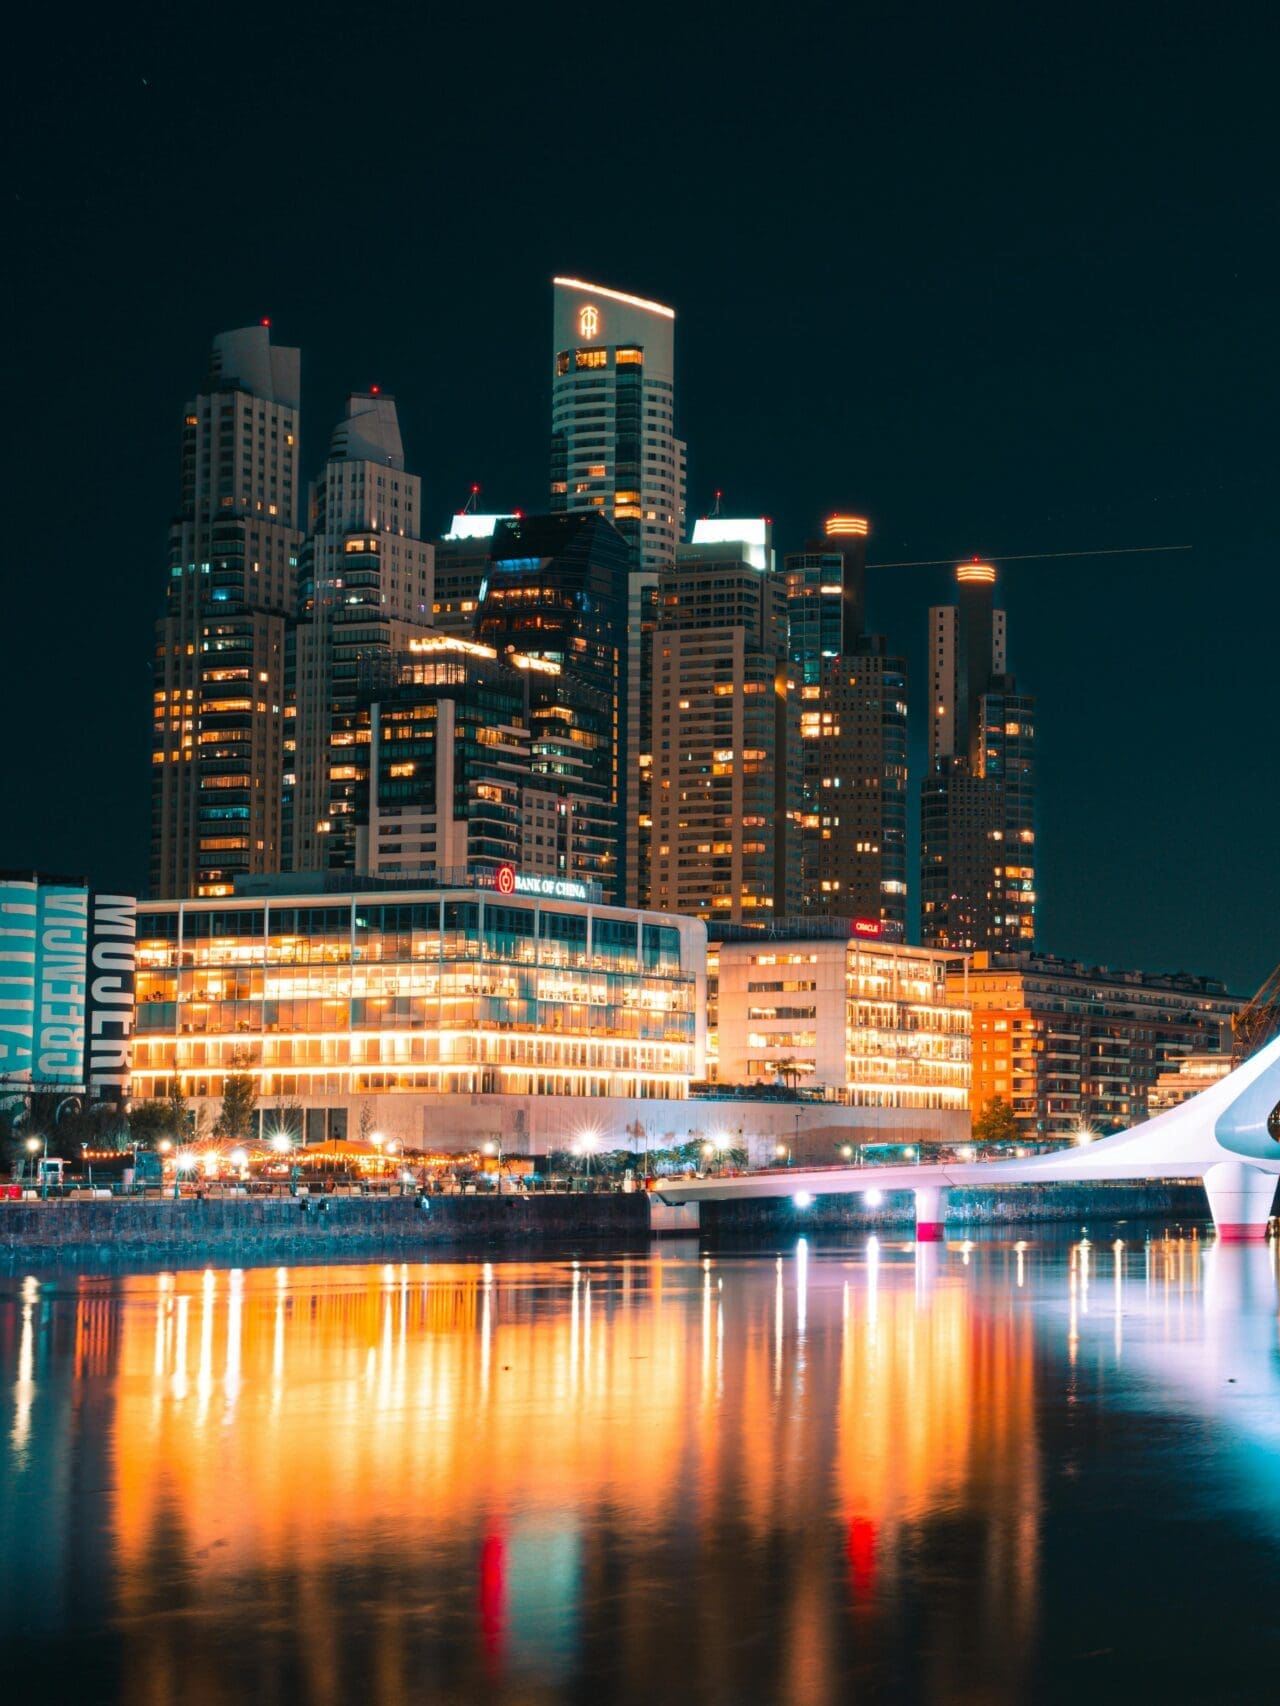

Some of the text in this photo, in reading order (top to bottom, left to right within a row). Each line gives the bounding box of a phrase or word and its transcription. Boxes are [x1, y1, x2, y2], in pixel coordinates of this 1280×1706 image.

[514, 875, 586, 898] BANK OF CHINA
[856, 922, 878, 933] ORACLE
